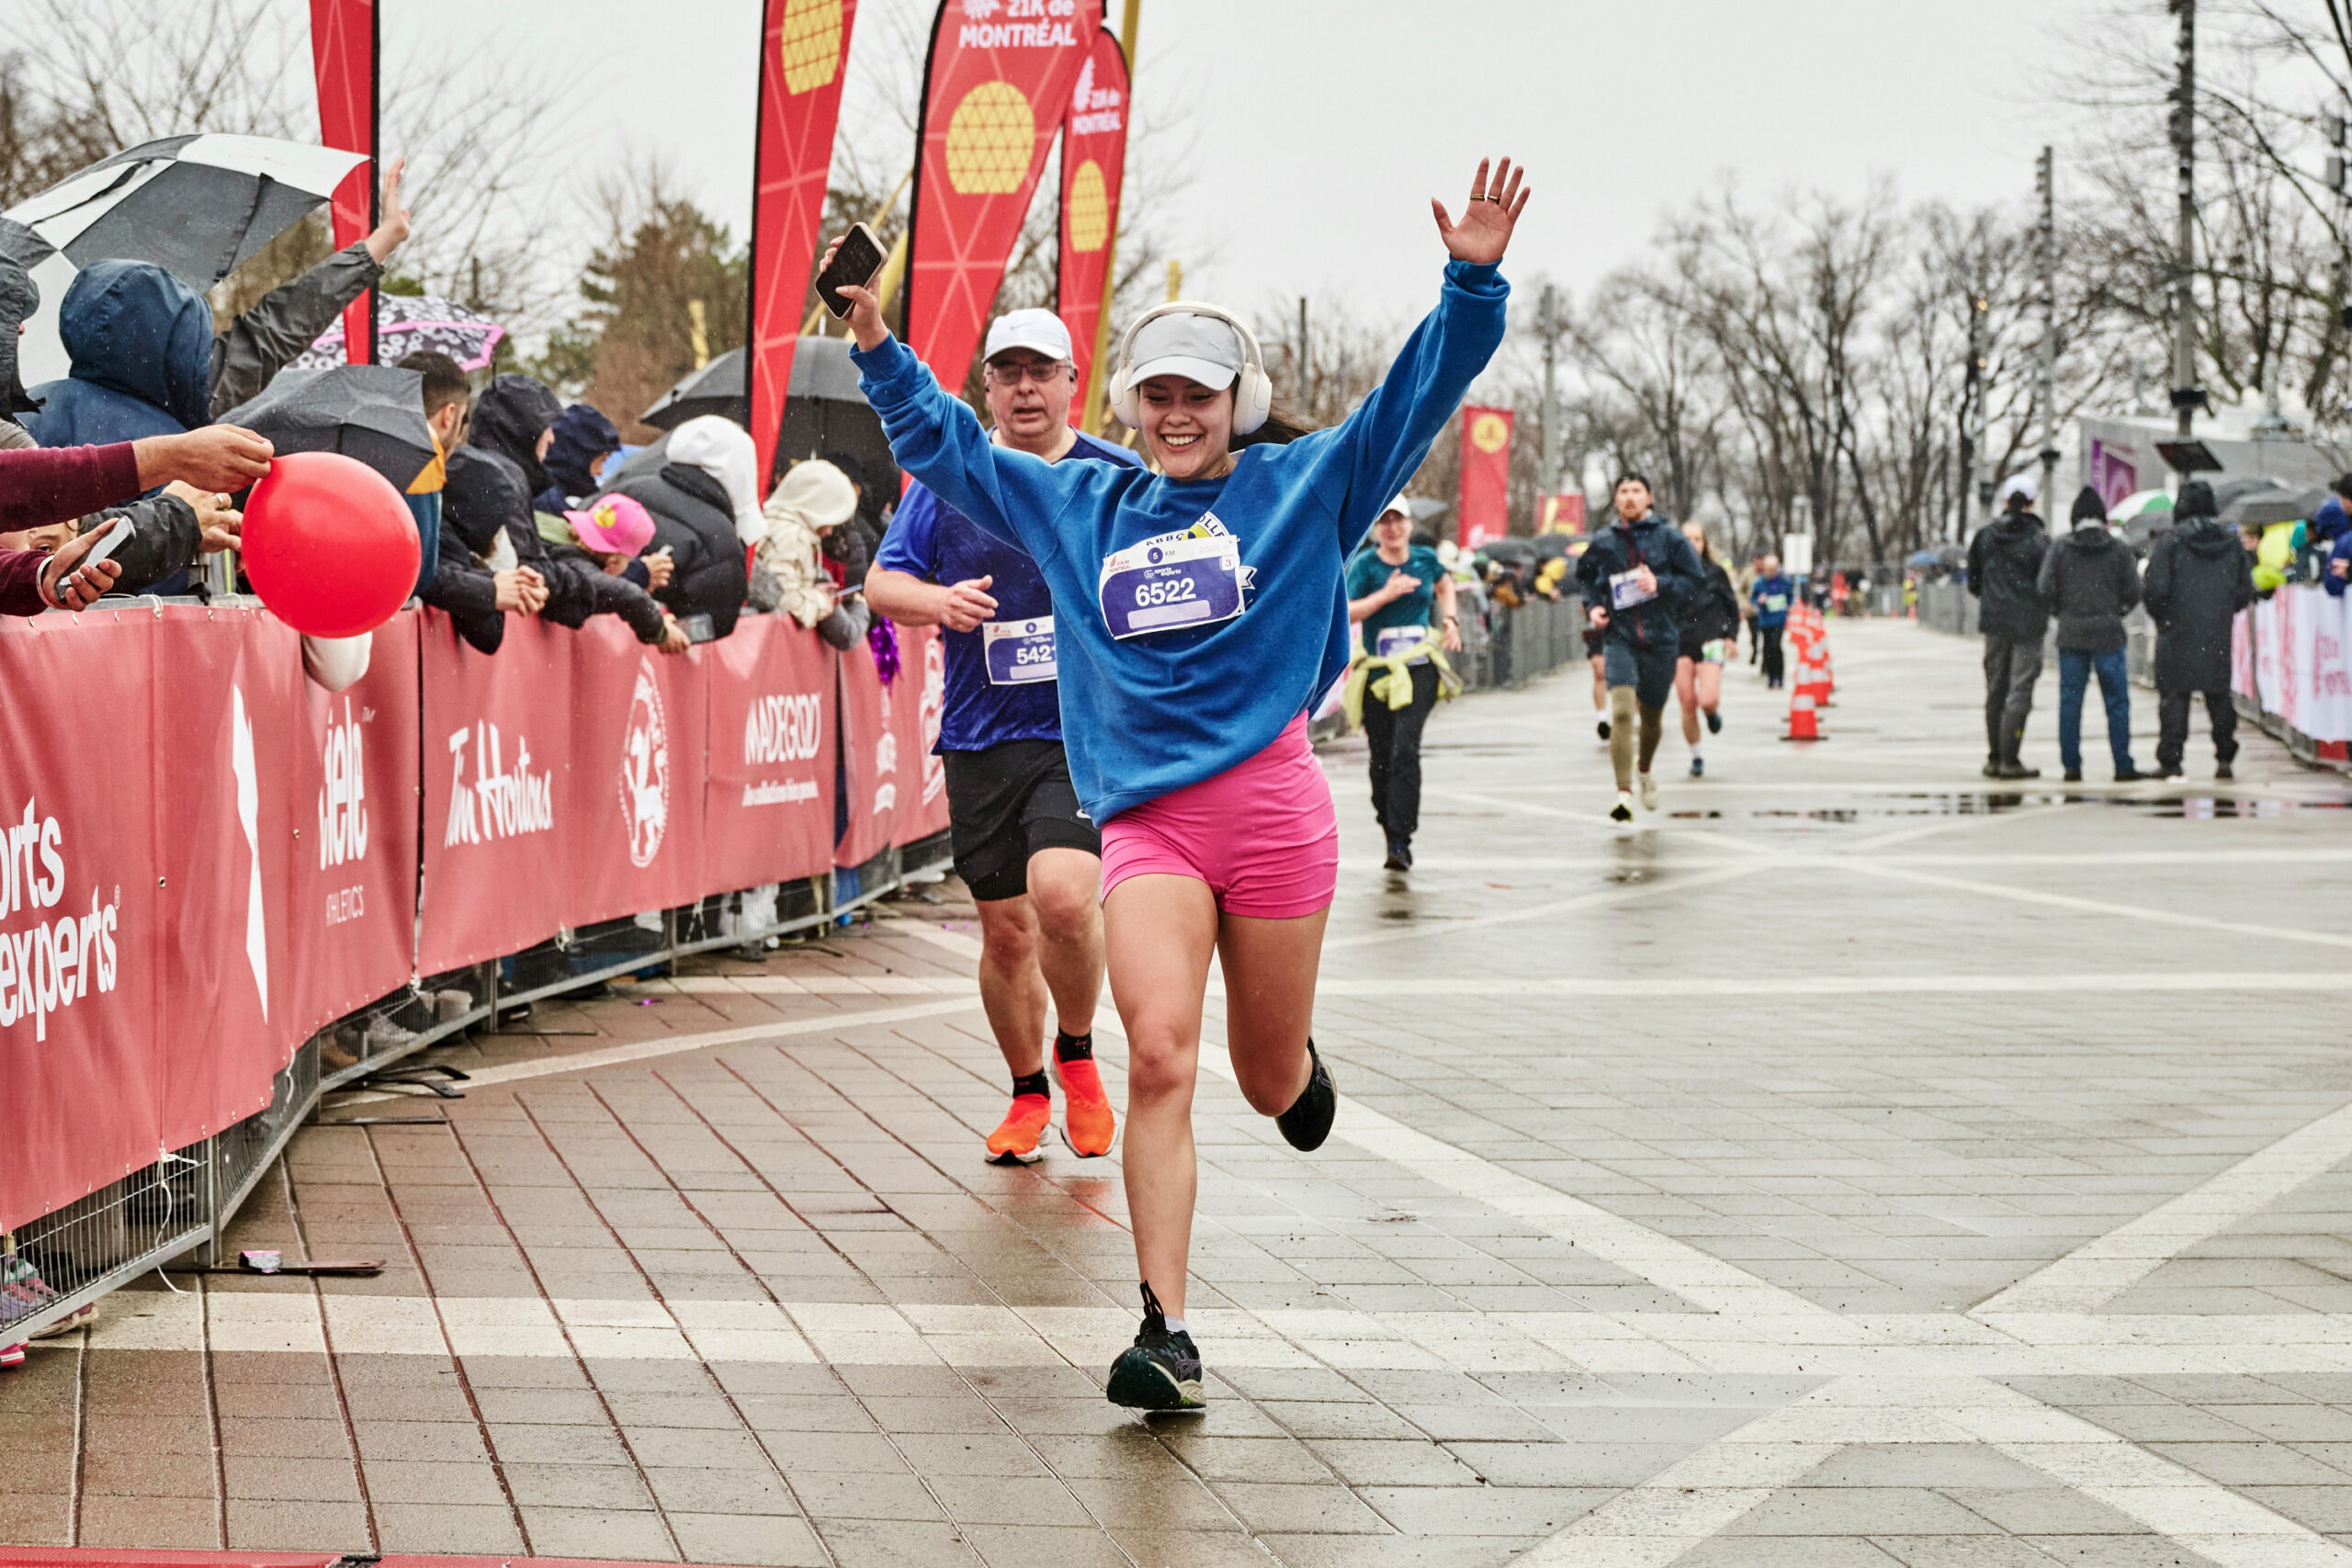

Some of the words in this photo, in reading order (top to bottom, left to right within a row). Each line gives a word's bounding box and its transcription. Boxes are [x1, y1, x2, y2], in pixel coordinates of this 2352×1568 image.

[1007, 0, 1047, 17] 21K
[1047, 0, 1075, 17] de
[959, 17, 1077, 49] MONTRÉAL
[1225, 558, 1232, 568] 3
[1135, 577, 1196, 607] 6522
[1016, 644, 1056, 665] 542
[445, 727, 481, 850] Tim
[475, 718, 553, 841] Hortons
